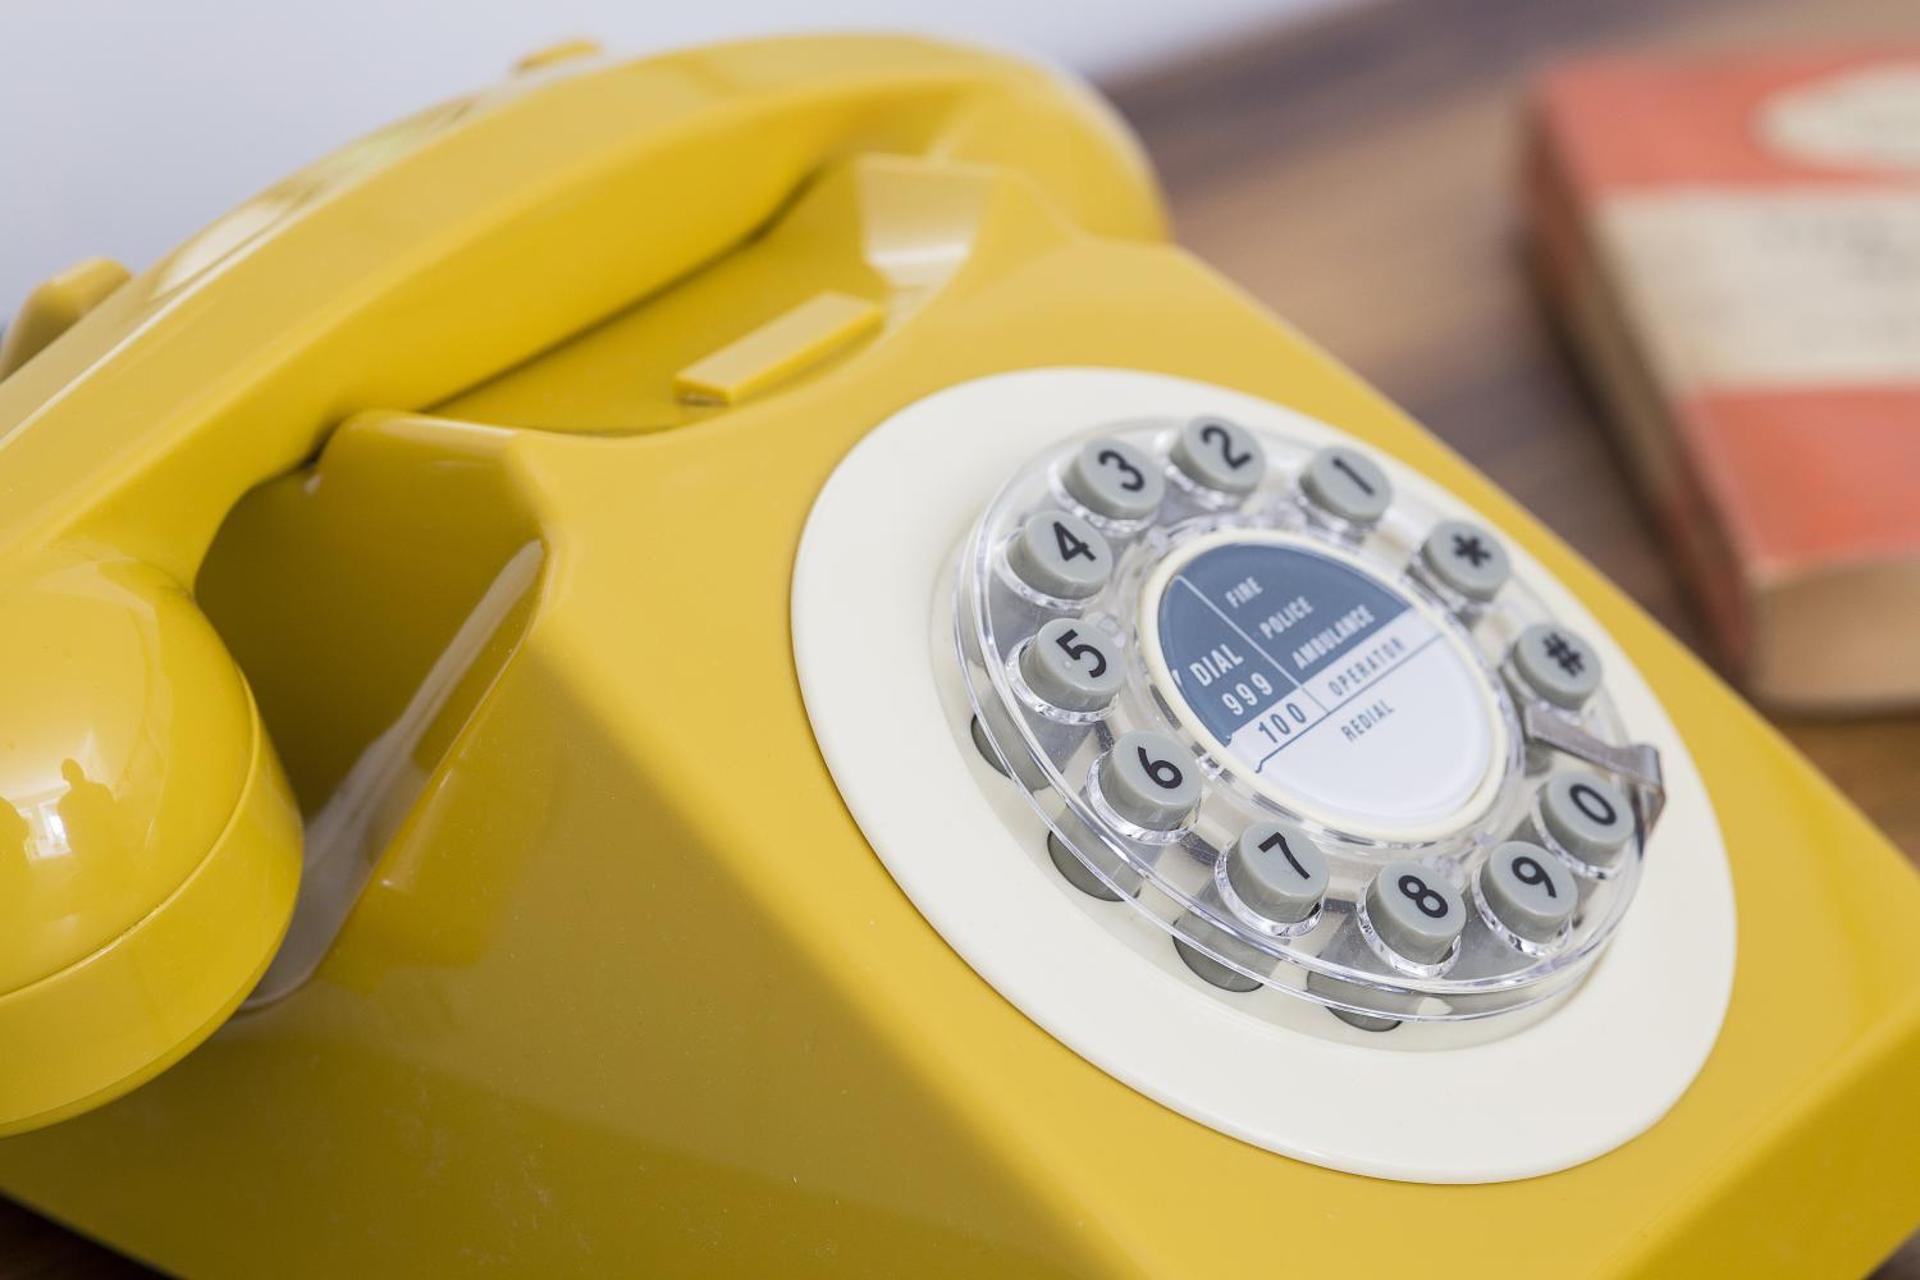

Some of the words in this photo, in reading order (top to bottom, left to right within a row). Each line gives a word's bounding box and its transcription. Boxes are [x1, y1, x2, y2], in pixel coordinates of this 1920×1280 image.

[1201, 426, 1251, 470] 2
[1098, 449, 1146, 492] 3
[1333, 458, 1376, 494] 1
[1052, 521, 1096, 563] 4
[1225, 576, 1263, 608] FIRE
[1259, 596, 1313, 639] POLICE
[1292, 604, 1375, 670] AMBULANCE
[1055, 629, 1107, 679] 5
[1189, 644, 1244, 687] DIAL
[1543, 635, 1584, 676] #
[1222, 672, 1273, 716] 999
[1258, 703, 1306, 743] 100
[1328, 637, 1405, 696] OPERATOR
[1341, 700, 1395, 743] REDIAL
[1137, 746, 1183, 790] 6
[1569, 783, 1618, 826] 0
[1257, 831, 1311, 880] 7
[1511, 855, 1558, 899] 9
[1398, 874, 1449, 919] 8
